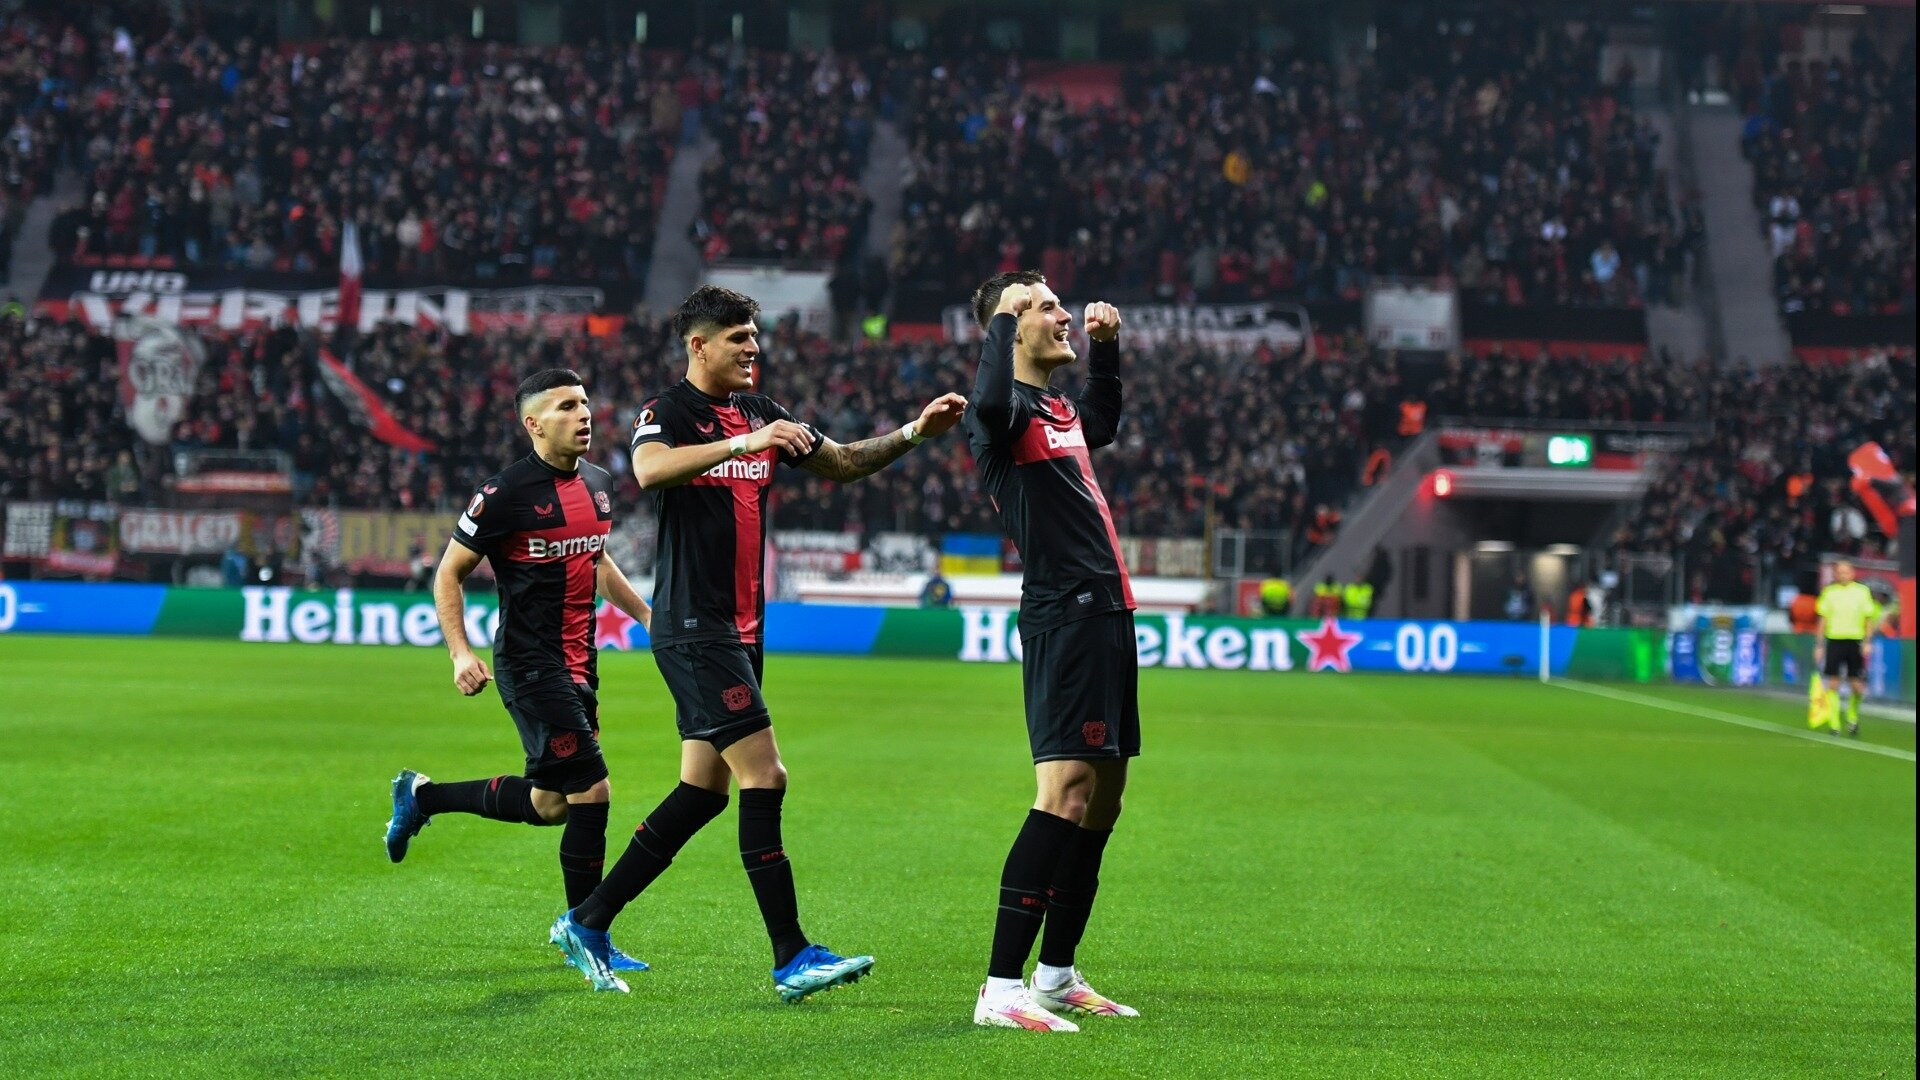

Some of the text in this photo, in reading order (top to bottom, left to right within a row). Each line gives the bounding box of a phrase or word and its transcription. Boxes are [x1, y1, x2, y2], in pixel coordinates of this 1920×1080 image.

[90, 270, 185, 293] UND
[240, 586, 499, 648] Heinek
[958, 608, 1294, 671] Heken
[1395, 622, 1458, 672] 0.0
